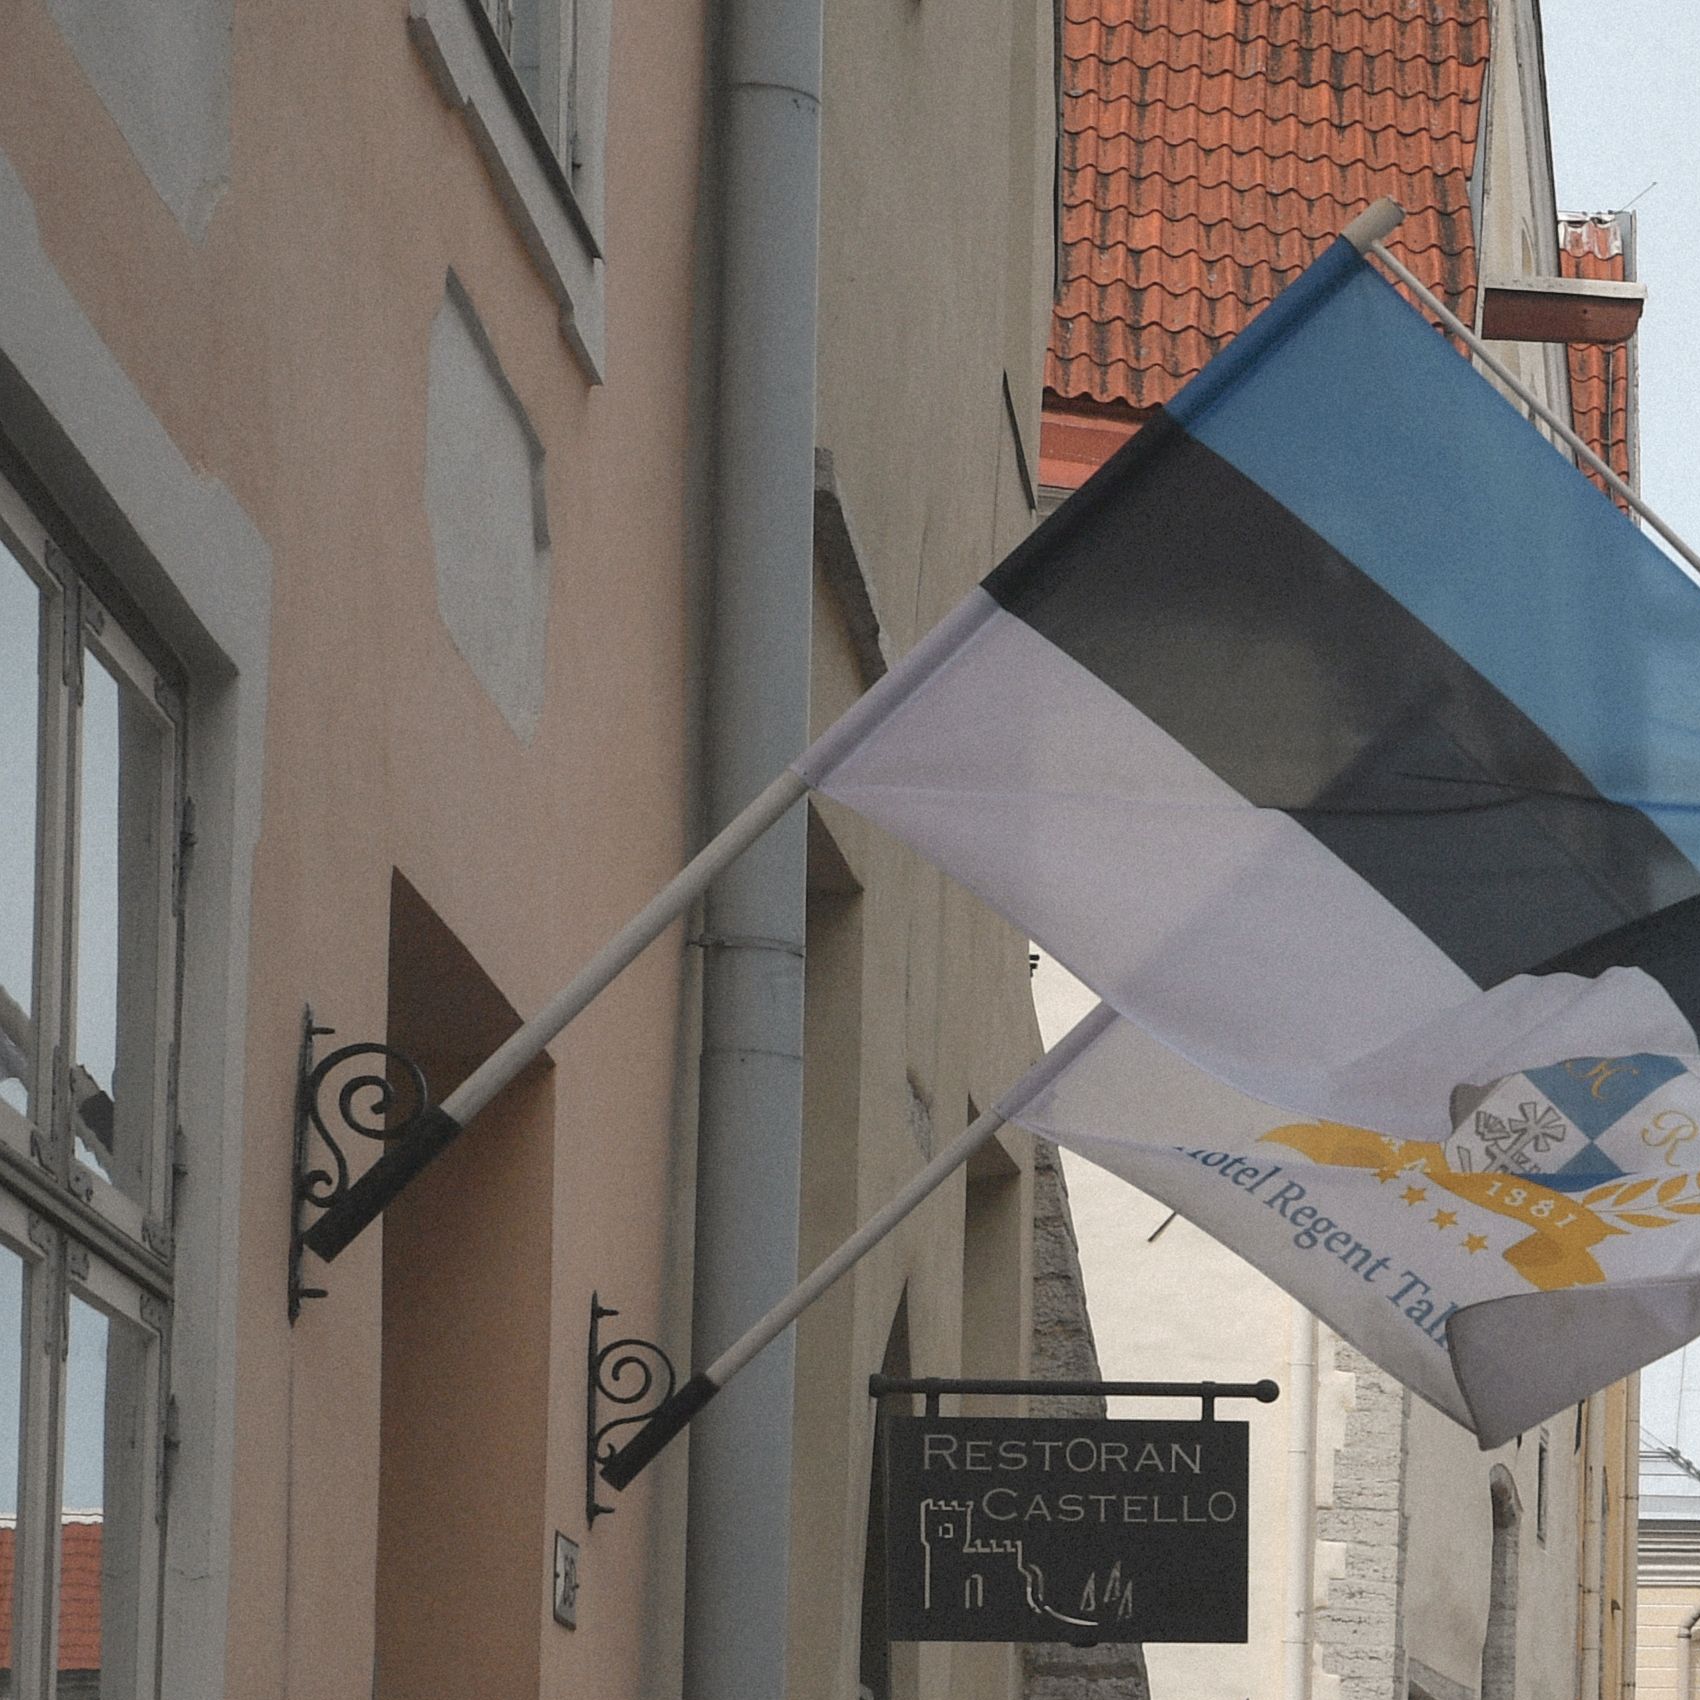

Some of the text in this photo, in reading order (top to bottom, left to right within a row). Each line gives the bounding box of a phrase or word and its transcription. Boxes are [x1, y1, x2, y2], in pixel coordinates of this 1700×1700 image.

[1173, 1146, 1282, 1194] otel
[1263, 1180, 1391, 1283] Regent
[1486, 1180, 1577, 1228] 1881
[923, 1433, 1202, 1473] RESTORAN
[982, 1487, 1237, 1523] CASTELLO
